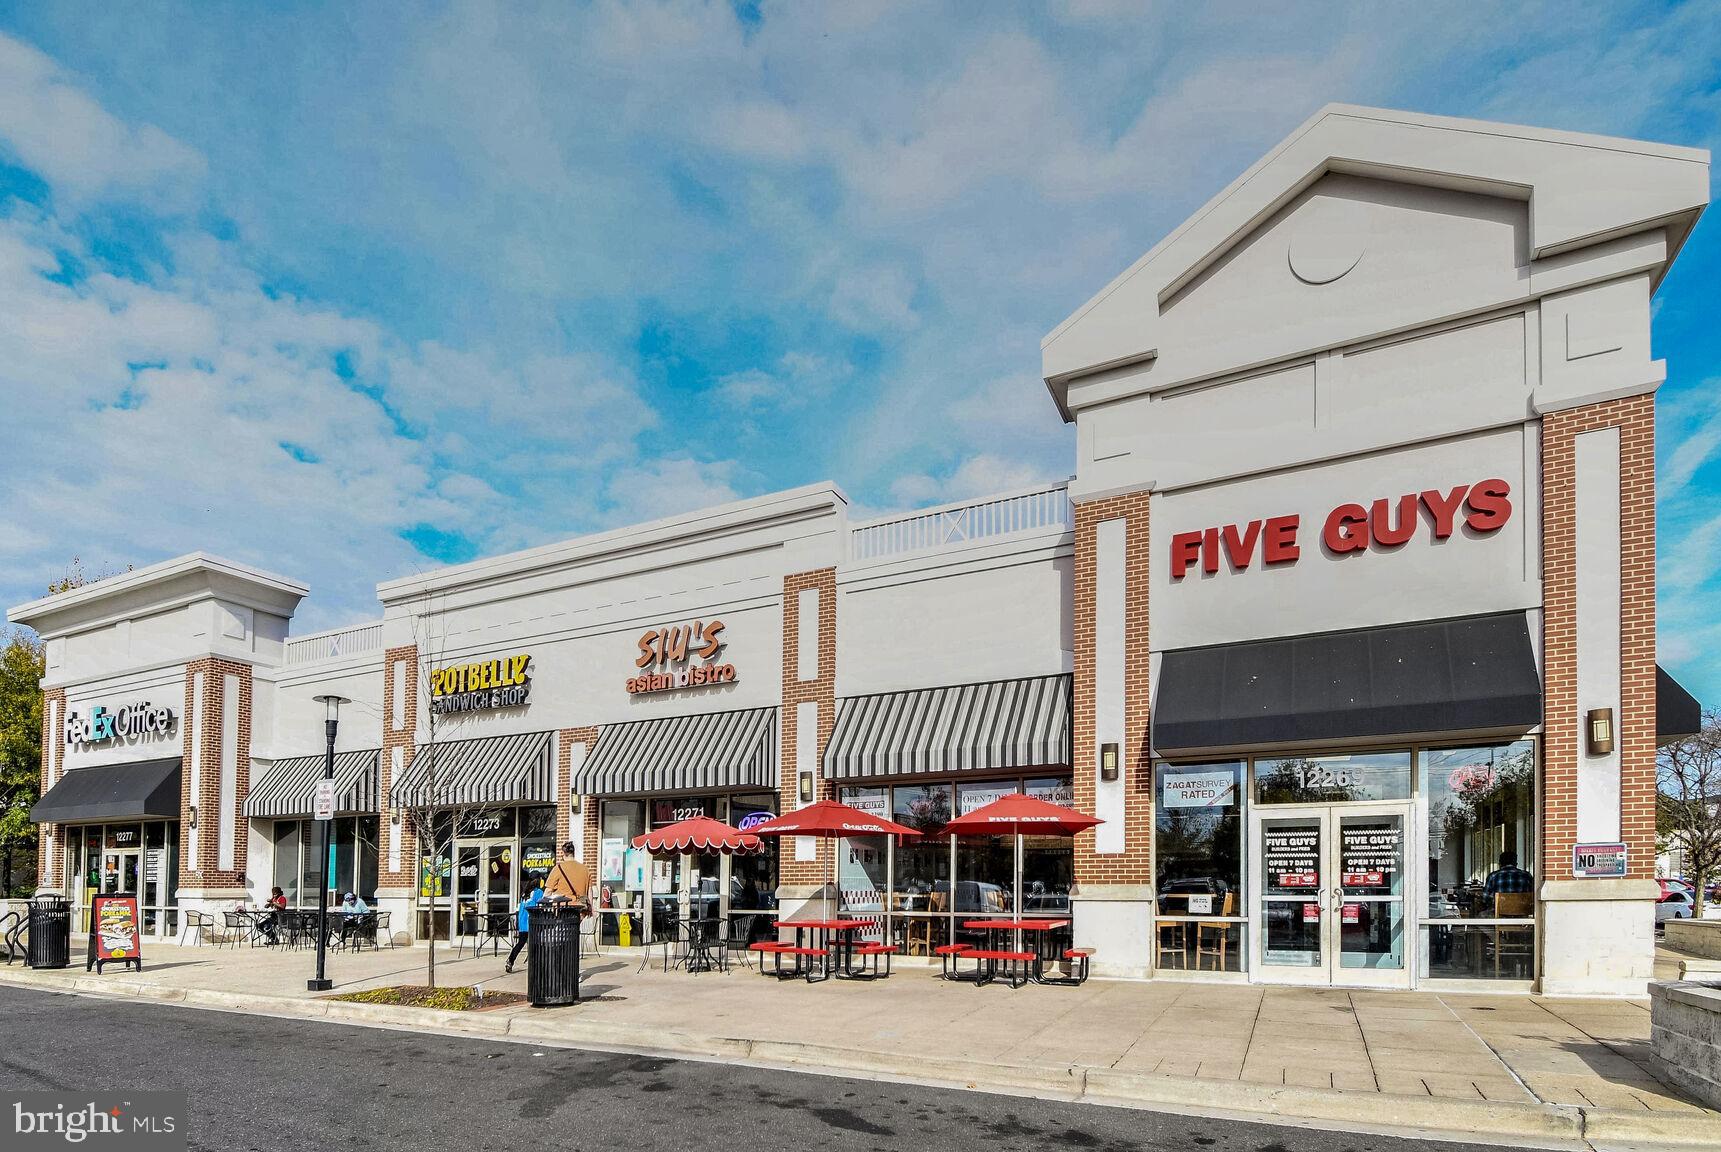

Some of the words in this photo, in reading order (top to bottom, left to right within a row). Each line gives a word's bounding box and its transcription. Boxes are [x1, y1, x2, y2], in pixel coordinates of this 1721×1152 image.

[1171, 513, 1300, 579] FIVE
[1322, 478, 1513, 555] GUYS
[431, 653, 531, 696] POTBELLY
[625, 670, 675, 695] asian
[675, 663, 737, 688] bistro
[432, 692, 489, 715] SANDWICH
[492, 685, 528, 708] SHOP
[65, 706, 116, 744] FedEx
[115, 701, 171, 738] Office
[963, 794, 986, 804] OPEN
[988, 794, 994, 803] 7
[1181, 789, 1216, 799] RATED
[672, 806, 706, 822] 12271
[474, 818, 501, 831] 12273
[116, 831, 133, 842] 12277
[1266, 837, 1289, 847] FIVE
[1289, 837, 1317, 846] GUYS
[1344, 836, 1368, 846] FIVE
[1369, 834, 1399, 845] GUYS
[1375, 858, 1396, 866] DAYS
[1579, 854, 1595, 868] NO
